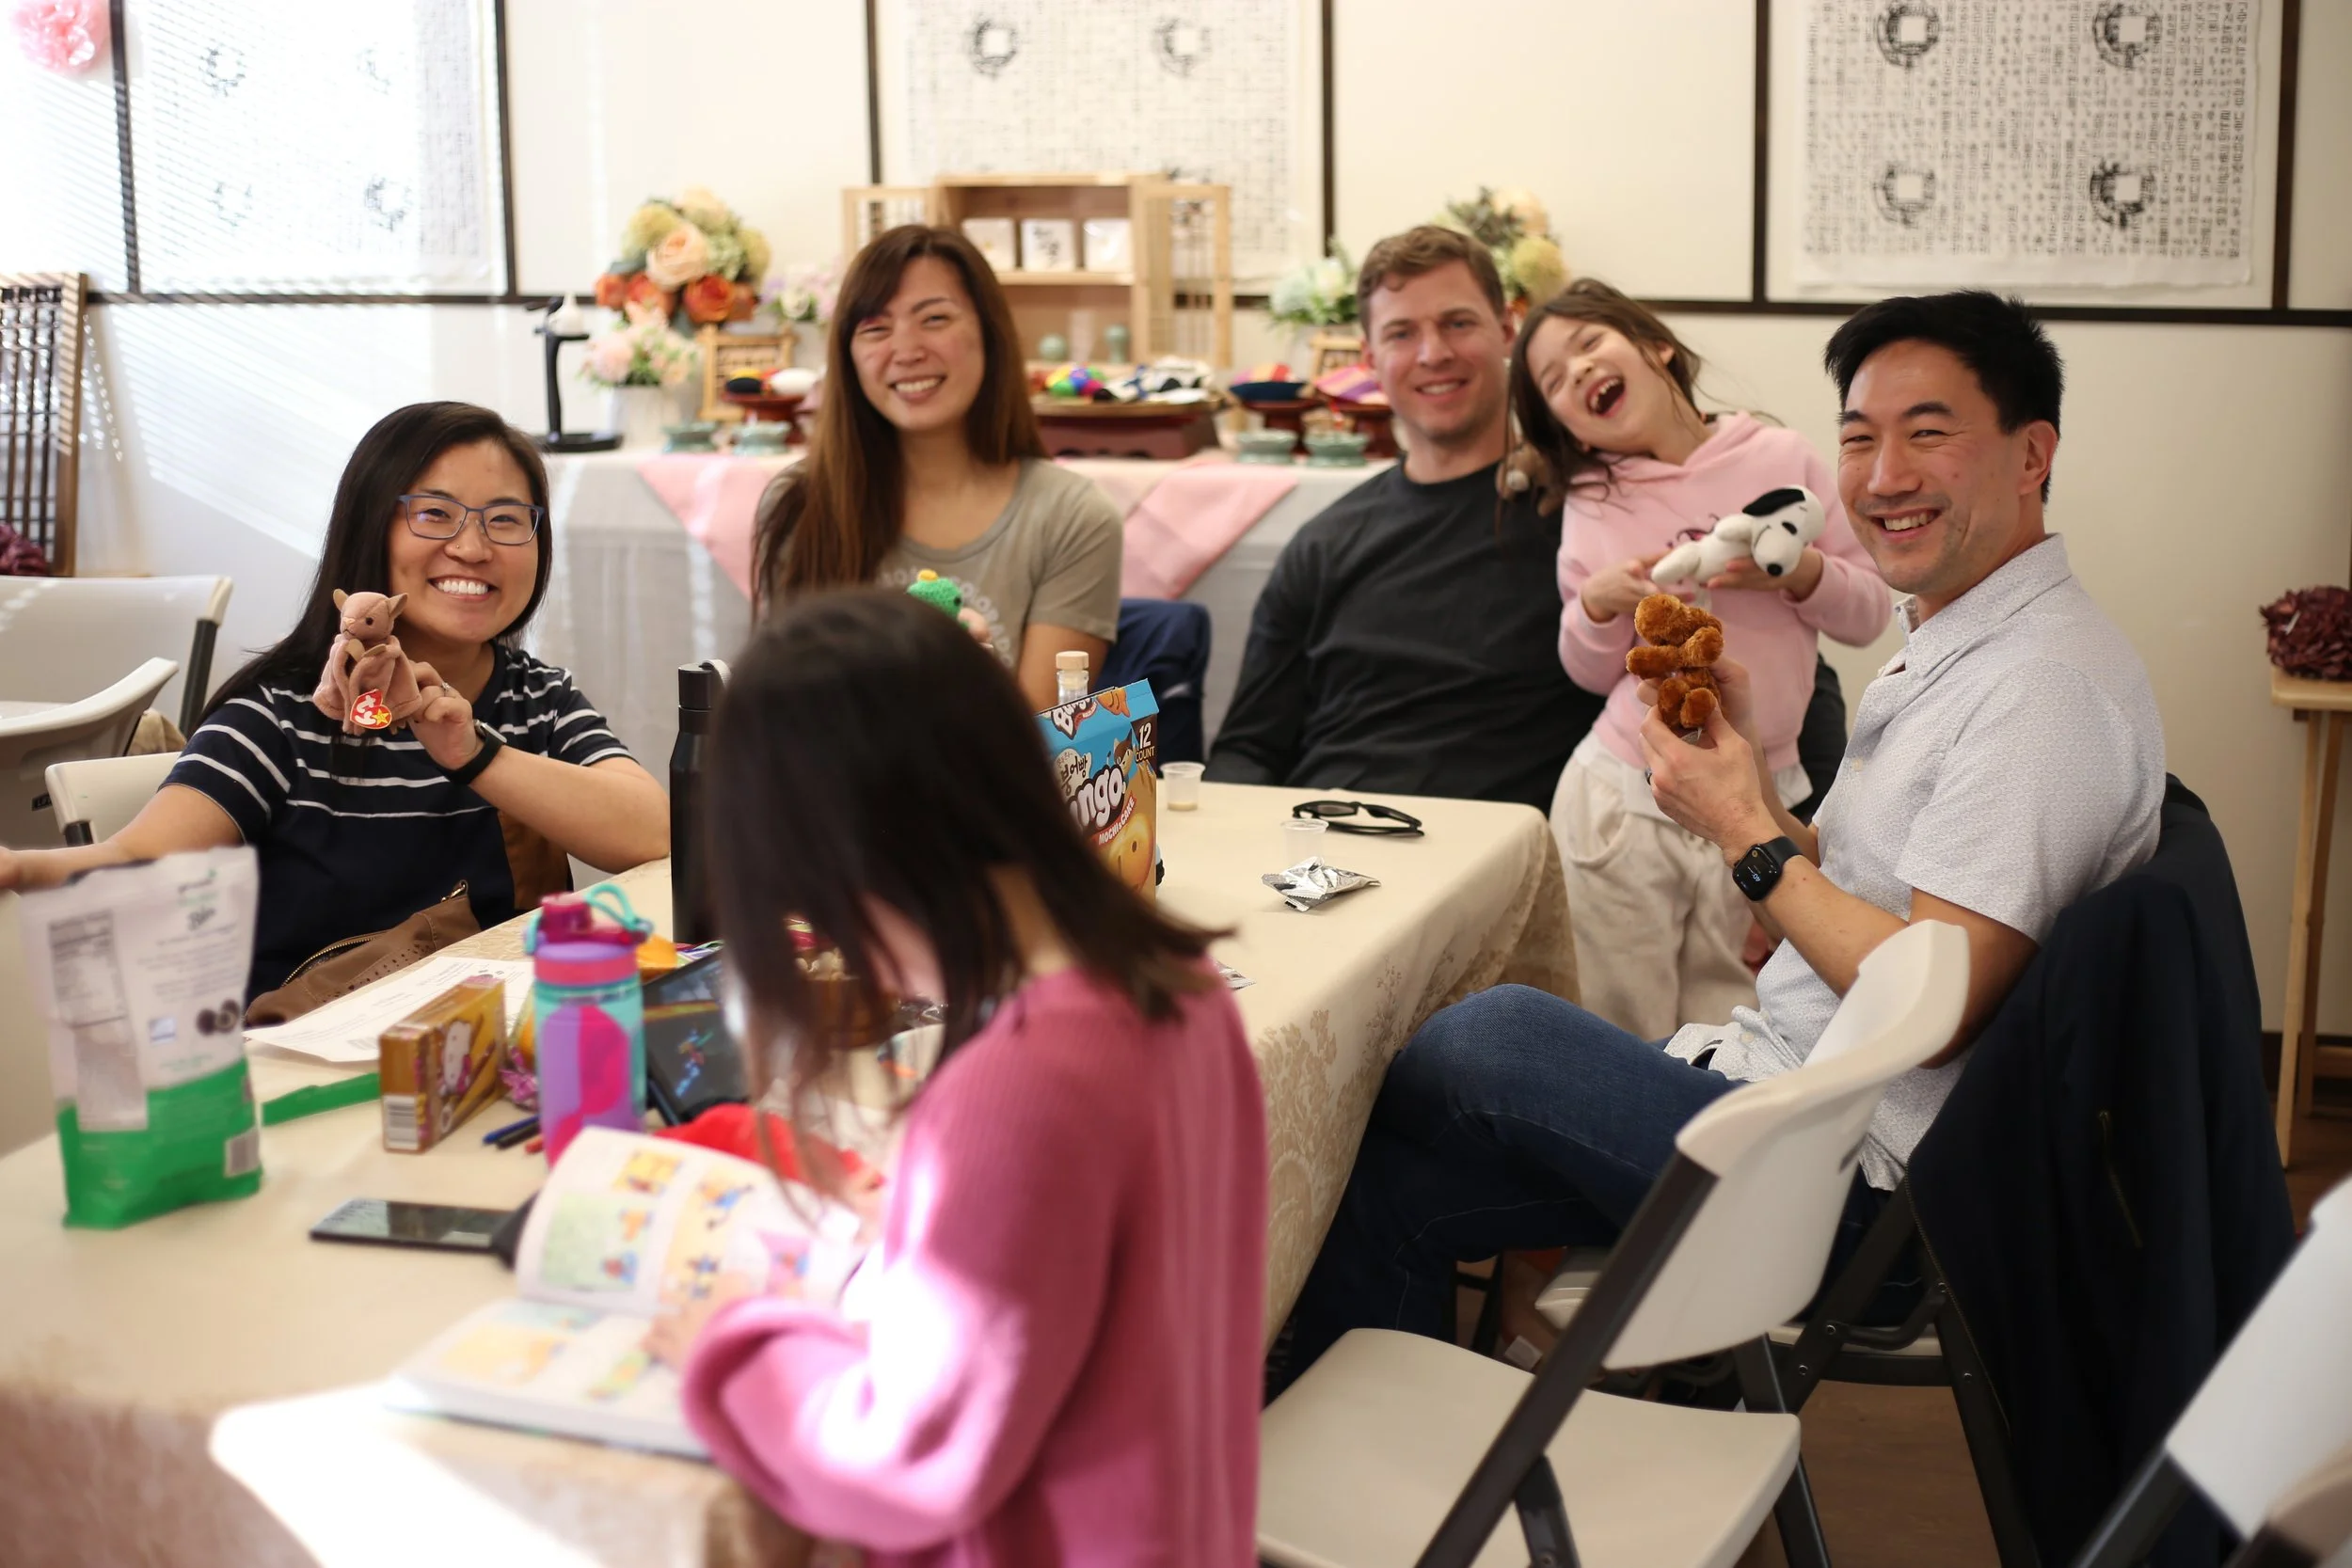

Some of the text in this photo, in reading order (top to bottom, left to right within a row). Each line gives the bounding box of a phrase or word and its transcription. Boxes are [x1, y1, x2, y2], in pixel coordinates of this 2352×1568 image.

[1136, 746, 1155, 763] COUNT
[1139, 722, 1152, 750] 12
[1060, 755, 1089, 797] 붕어빵
[1070, 768, 1123, 828] ngo
[1098, 822, 1119, 846] MOCHI
[1120, 797, 1136, 826] CAKE
